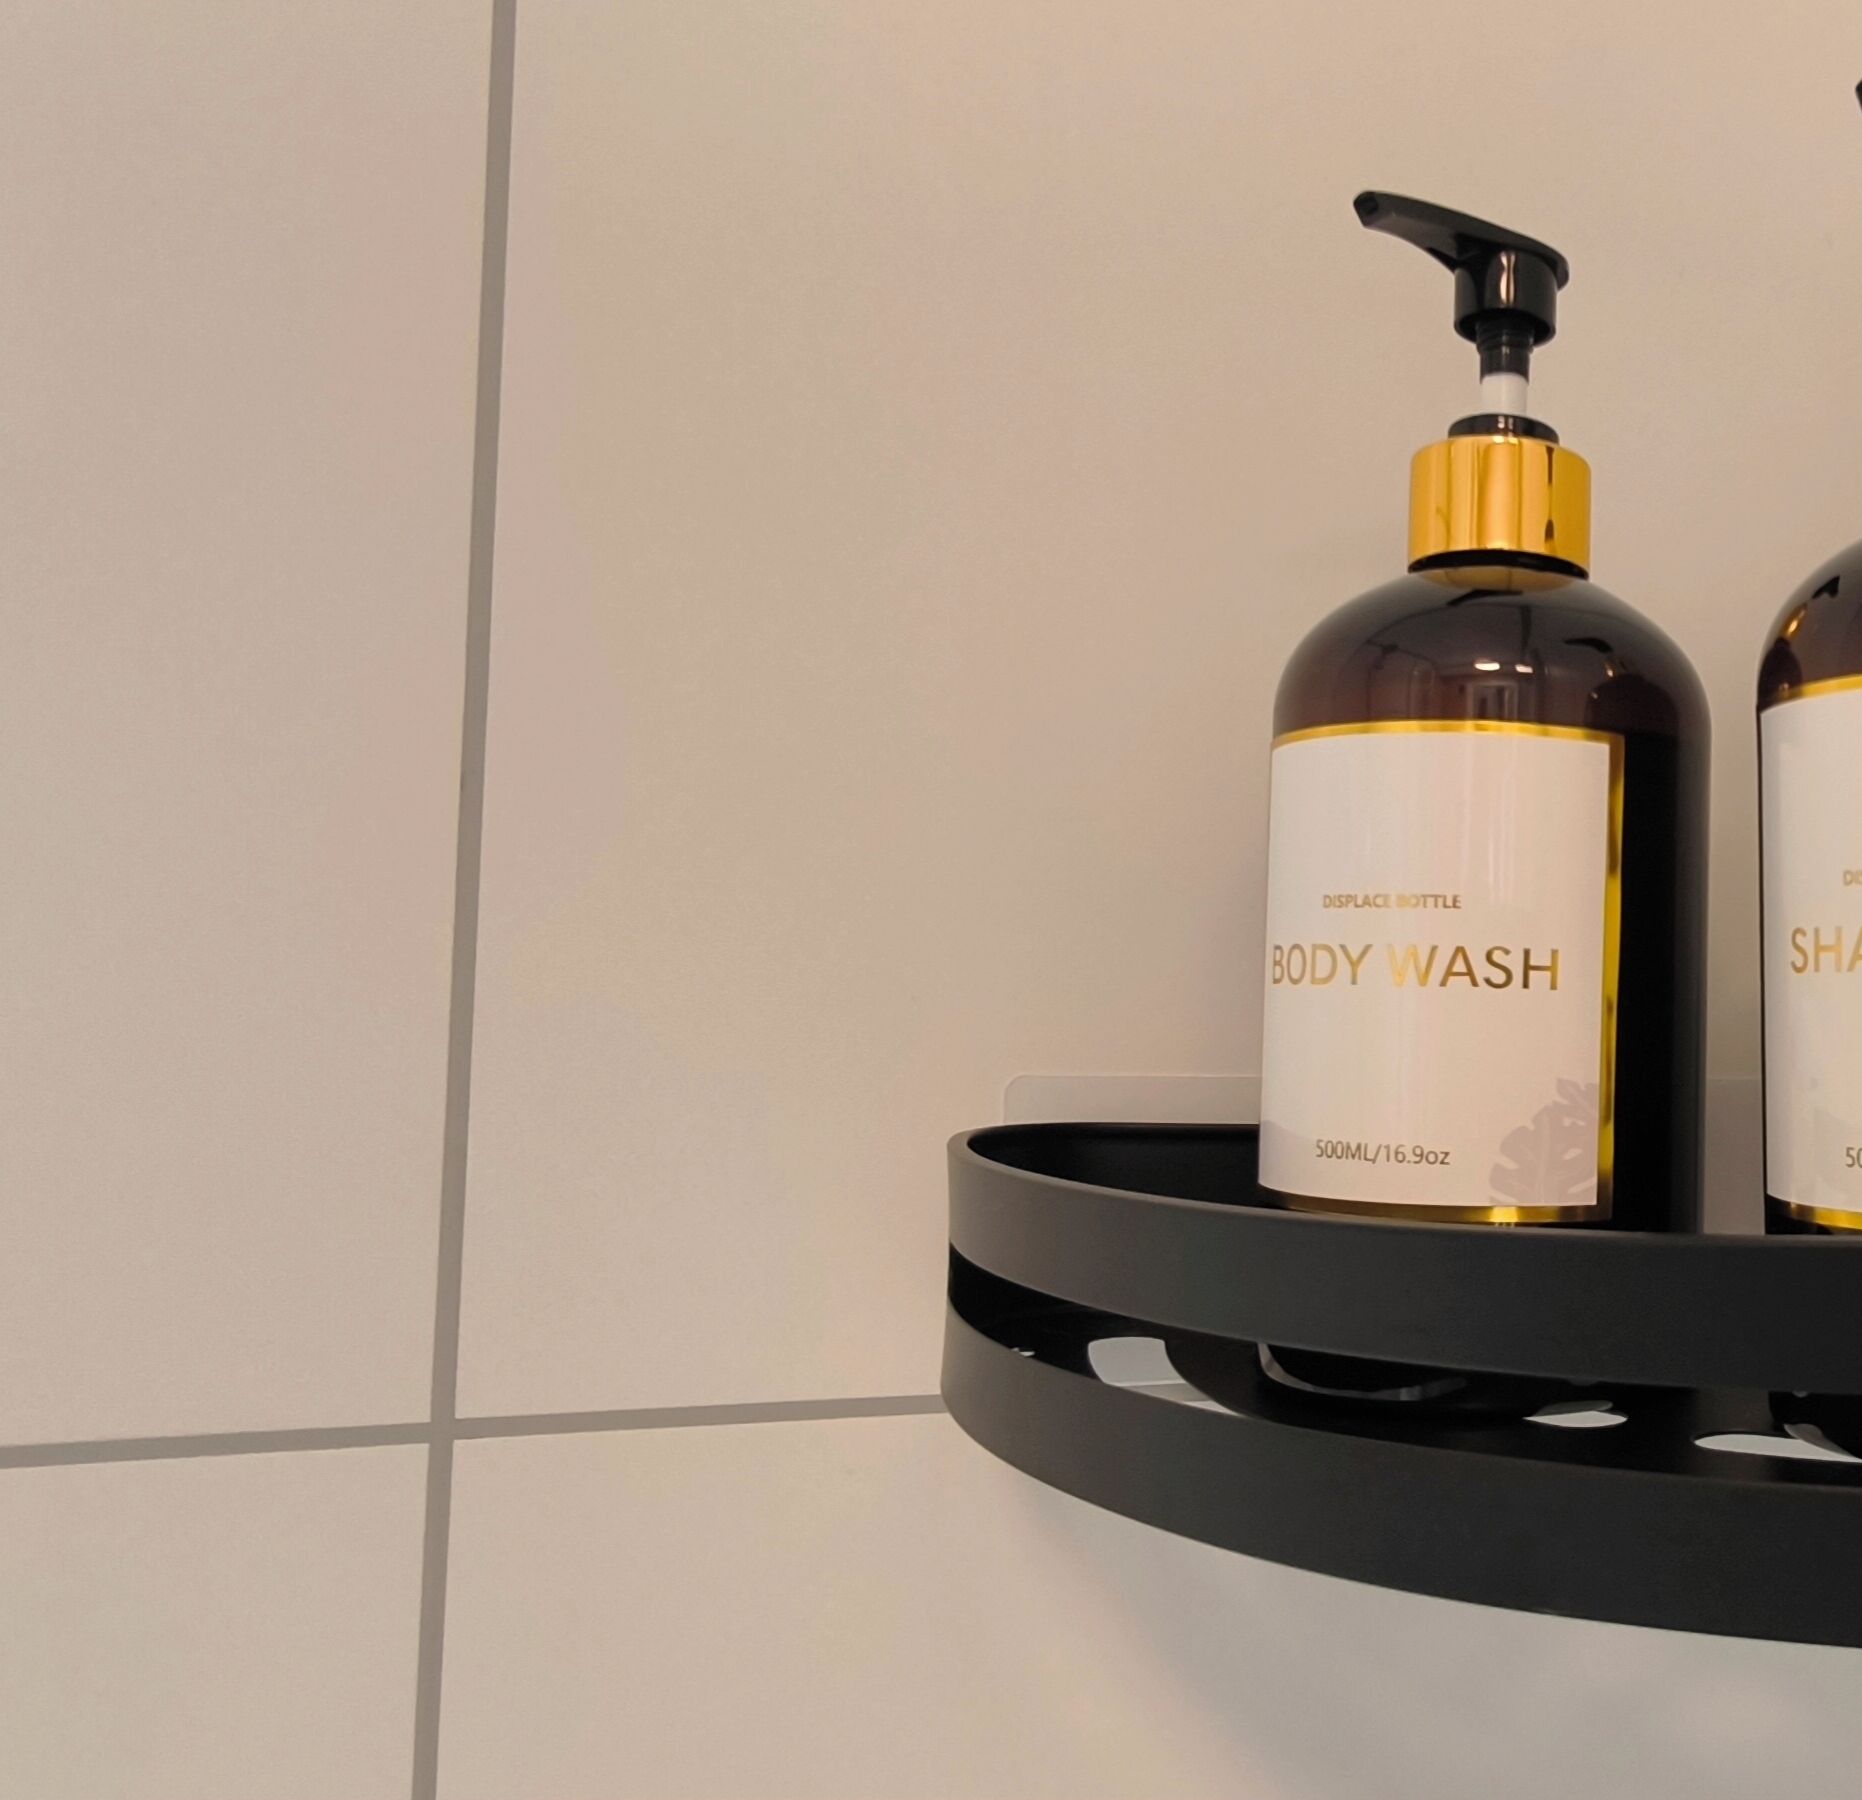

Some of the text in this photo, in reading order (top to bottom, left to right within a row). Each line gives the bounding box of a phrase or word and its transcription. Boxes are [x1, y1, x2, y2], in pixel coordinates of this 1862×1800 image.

[1322, 894, 1462, 909] DISPLACE BOTTLE
[1272, 943, 1560, 991] BODY WASH
[1315, 1139, 1450, 1166] 500ML/16.9oz
